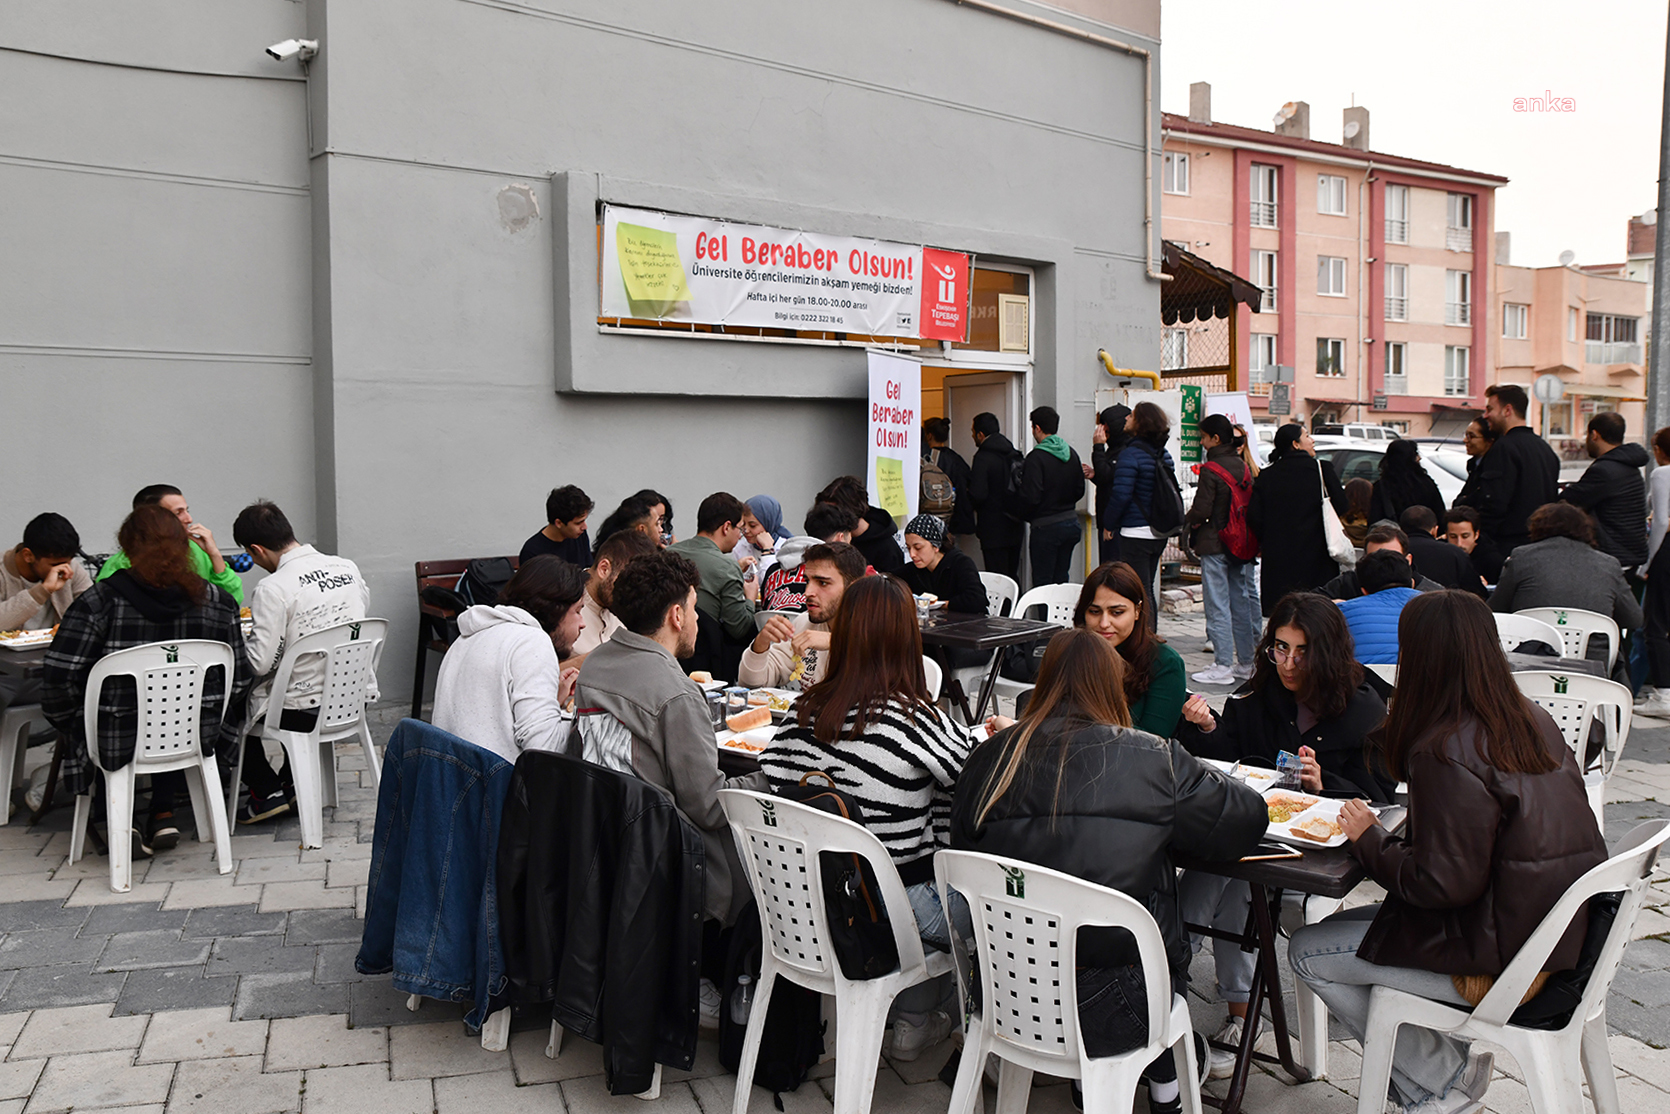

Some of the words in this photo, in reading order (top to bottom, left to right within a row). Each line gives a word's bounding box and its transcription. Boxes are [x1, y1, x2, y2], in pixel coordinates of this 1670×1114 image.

[695, 231, 728, 262] Gel
[741, 236, 839, 272] Beraber
[849, 249, 913, 281] Olsun!
[692, 262, 743, 279] Üniversite
[744, 269, 820, 286] öğrencilerimizin
[821, 277, 850, 289] akşam
[851, 282, 882, 294] yemeği
[883, 283, 913, 295] bizden!
[746, 292, 768, 301] Hafta
[769, 293, 779, 303] içi
[779, 294, 792, 303] her
[793, 296, 806, 306] gün
[807, 296, 852, 308] 18.00-20.00
[853, 302, 868, 310] arası
[775, 312, 787, 321] Bilgi
[800, 314, 817, 322] 0222
[818, 315, 829, 323] 322
[830, 315, 836, 323] 18
[836, 316, 844, 324] 45
[886, 379, 901, 400] Gel
[872, 402, 914, 425] Beraber
[876, 427, 908, 448] Olsun!
[299, 569, 329, 587] ANTI-
[318, 573, 356, 592] POSER
